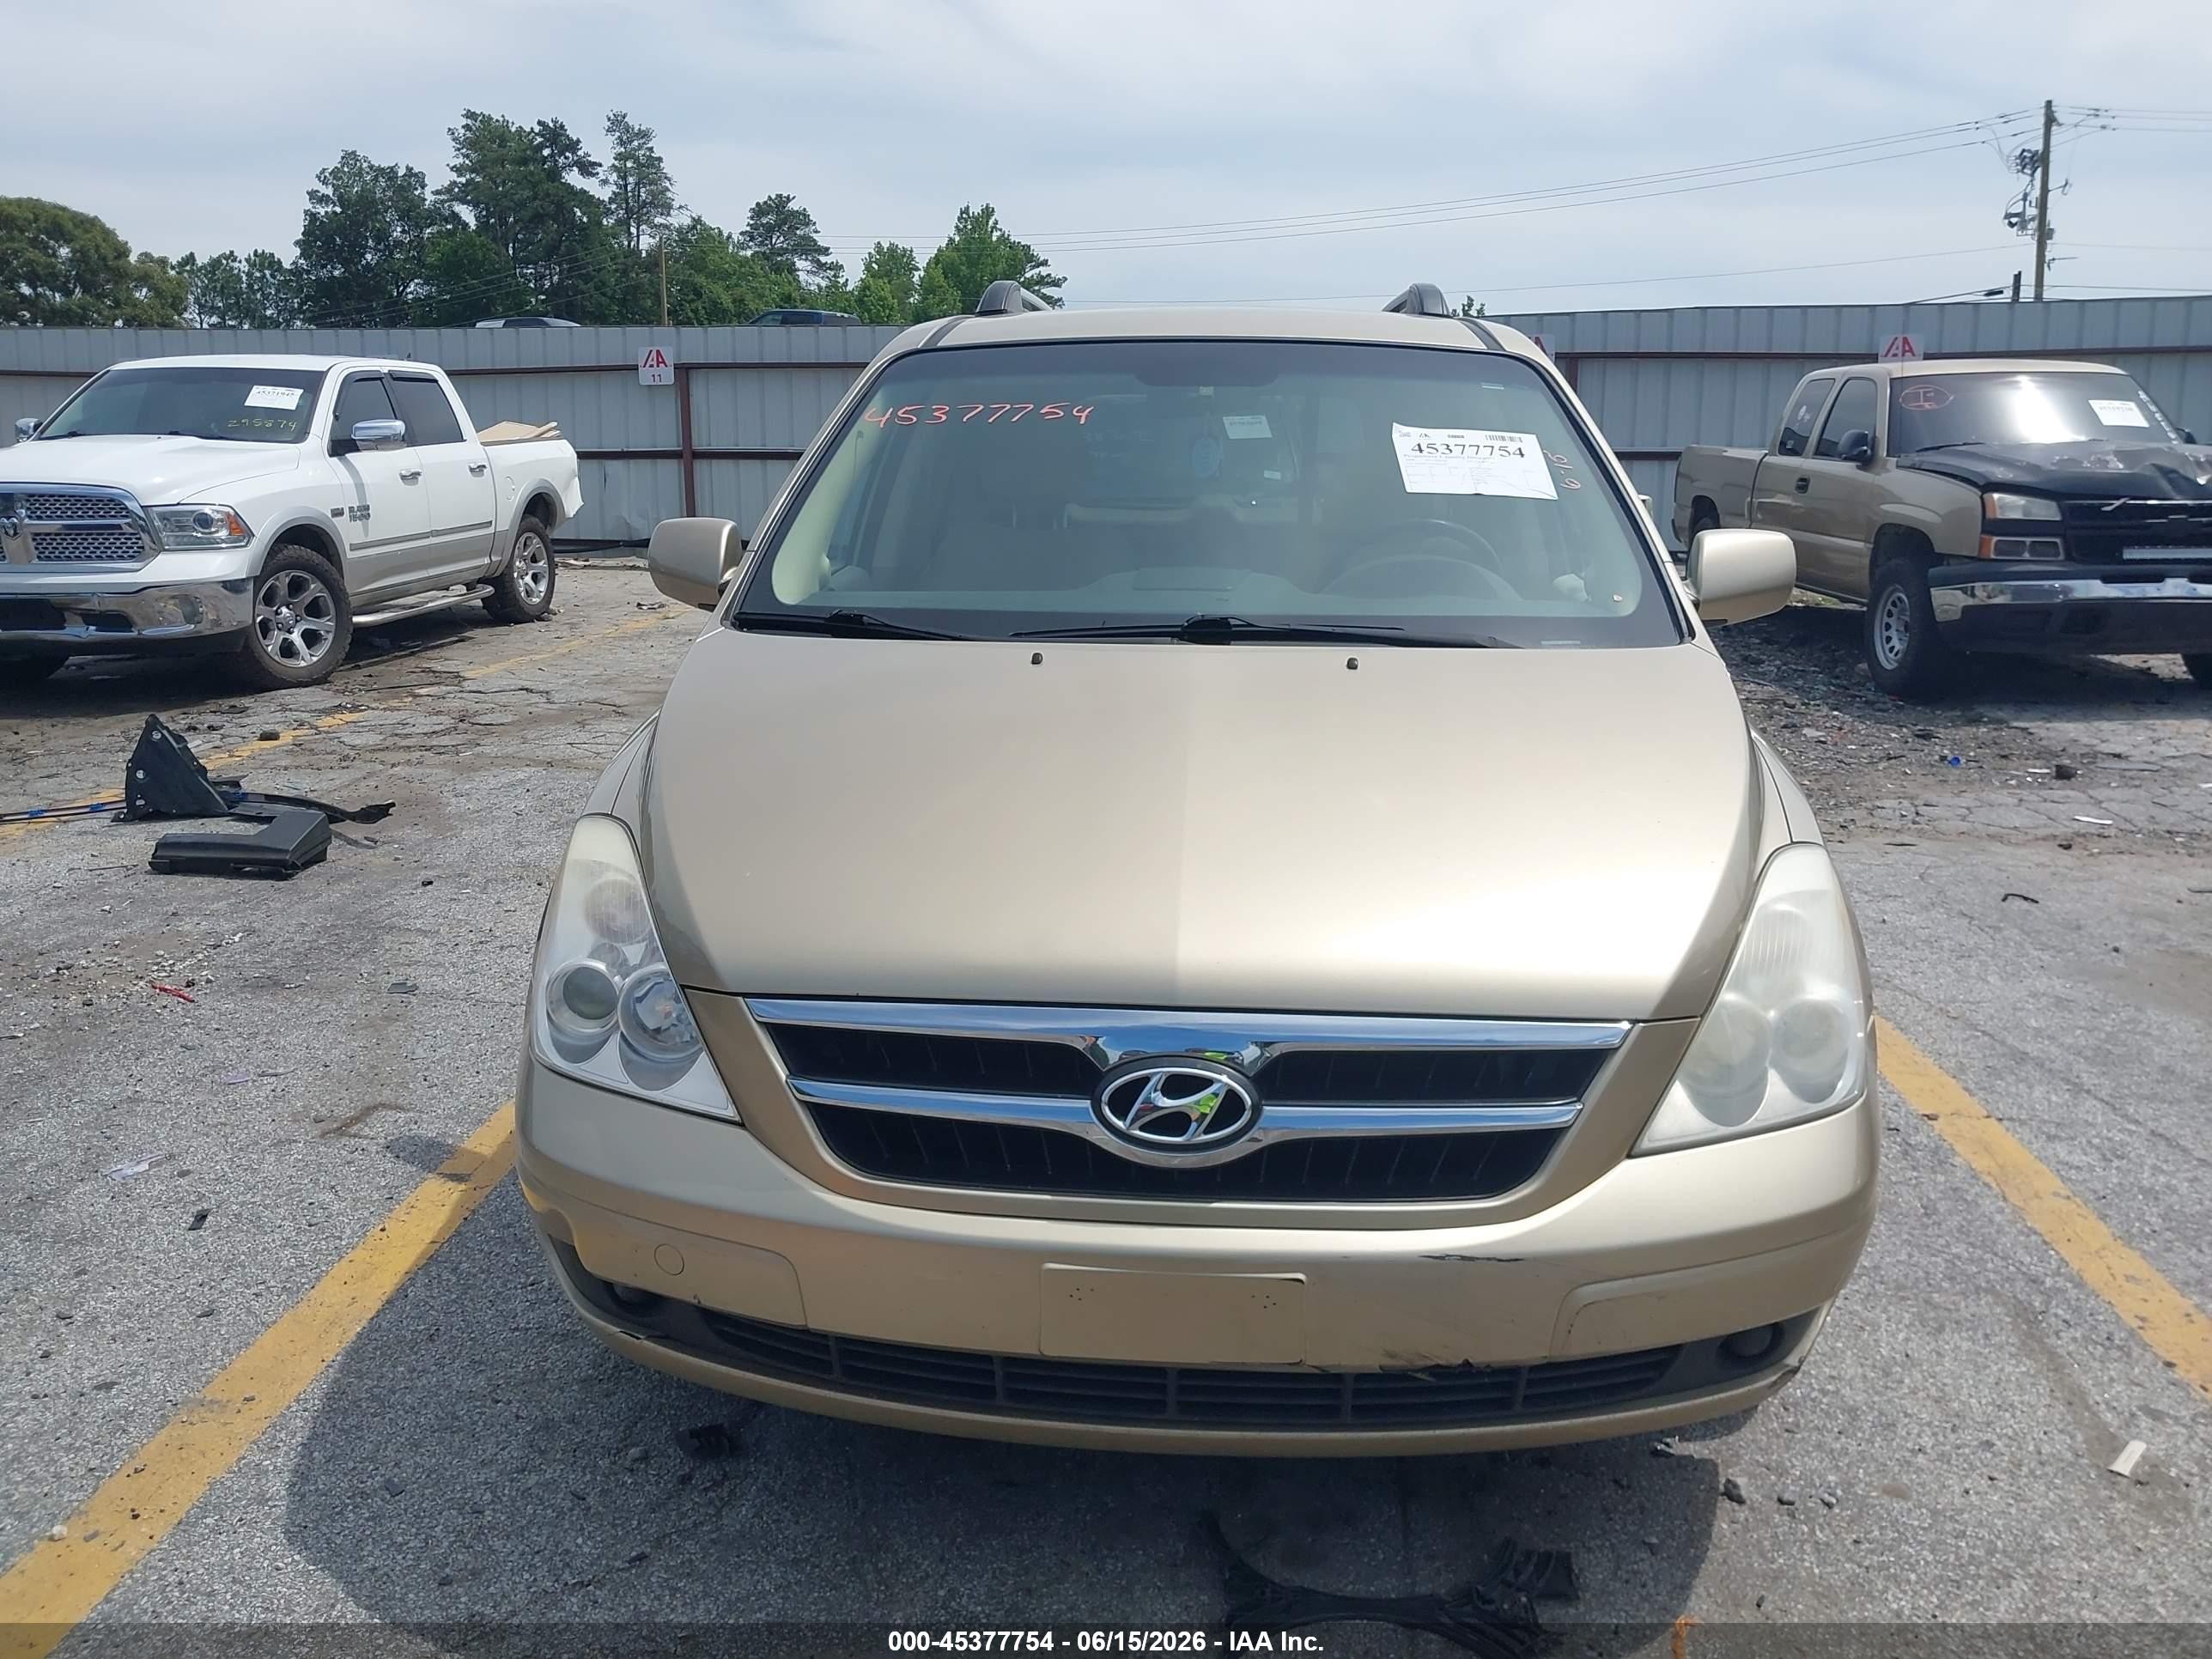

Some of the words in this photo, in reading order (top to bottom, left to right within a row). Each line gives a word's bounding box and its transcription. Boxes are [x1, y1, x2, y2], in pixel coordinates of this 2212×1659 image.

[652, 374, 661, 383] 11
[864, 402, 1095, 428] 45377754
[1411, 442, 1526, 459] 45377754
